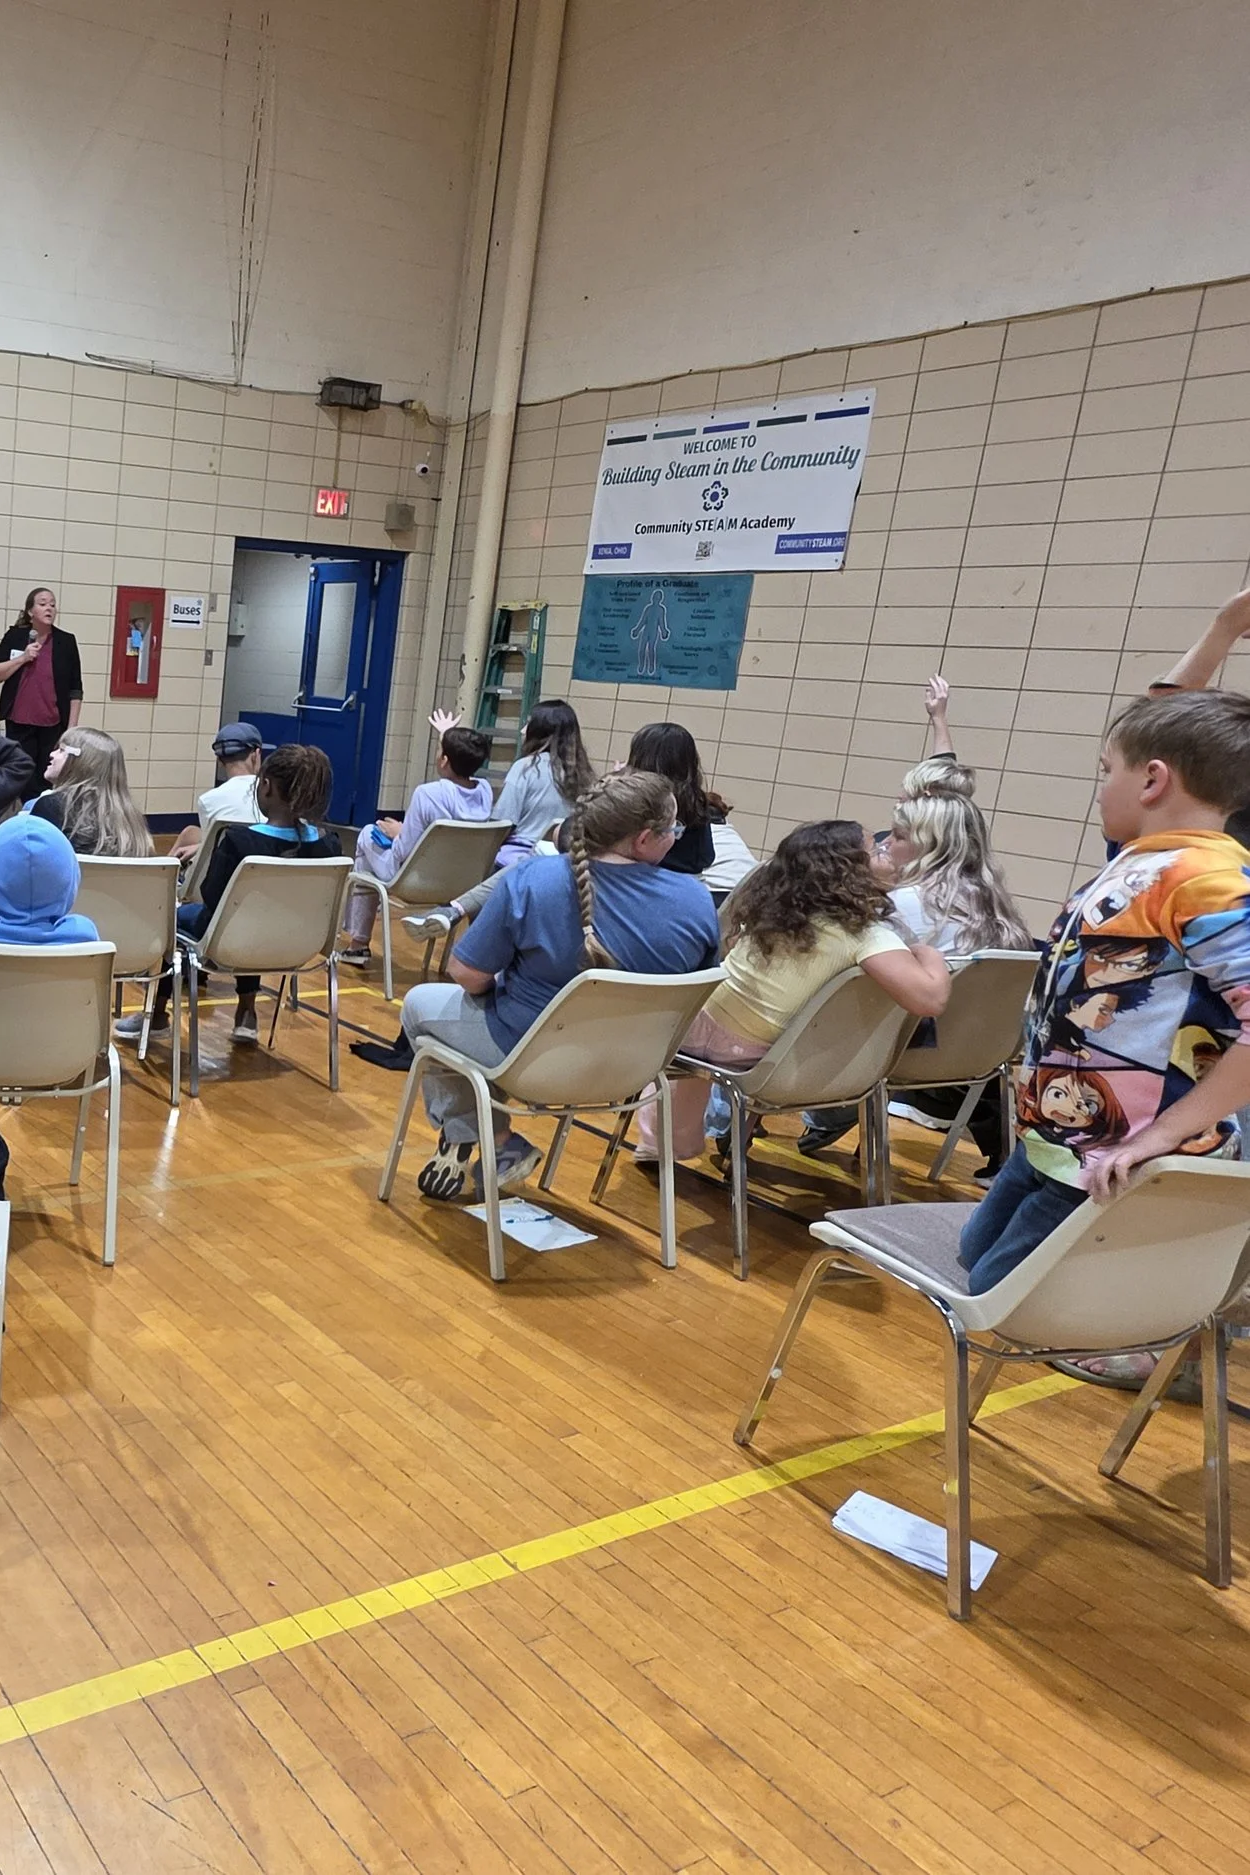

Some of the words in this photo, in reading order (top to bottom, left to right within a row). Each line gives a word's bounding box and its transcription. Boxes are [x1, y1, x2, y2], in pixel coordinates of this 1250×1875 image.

[683, 436, 738, 455] WELCOME
[741, 435, 757, 449] TO
[602, 465, 662, 487] Building
[665, 460, 710, 480] Steam
[713, 458, 729, 476] in
[732, 455, 757, 474] the
[761, 445, 861, 471] Community
[316, 489, 349, 515] EXIT
[634, 520, 693, 536] Community
[740, 515, 796, 531] Academy
[616, 579, 643, 588] Profile
[644, 579, 654, 588] of
[173, 603, 201, 616] Buses
